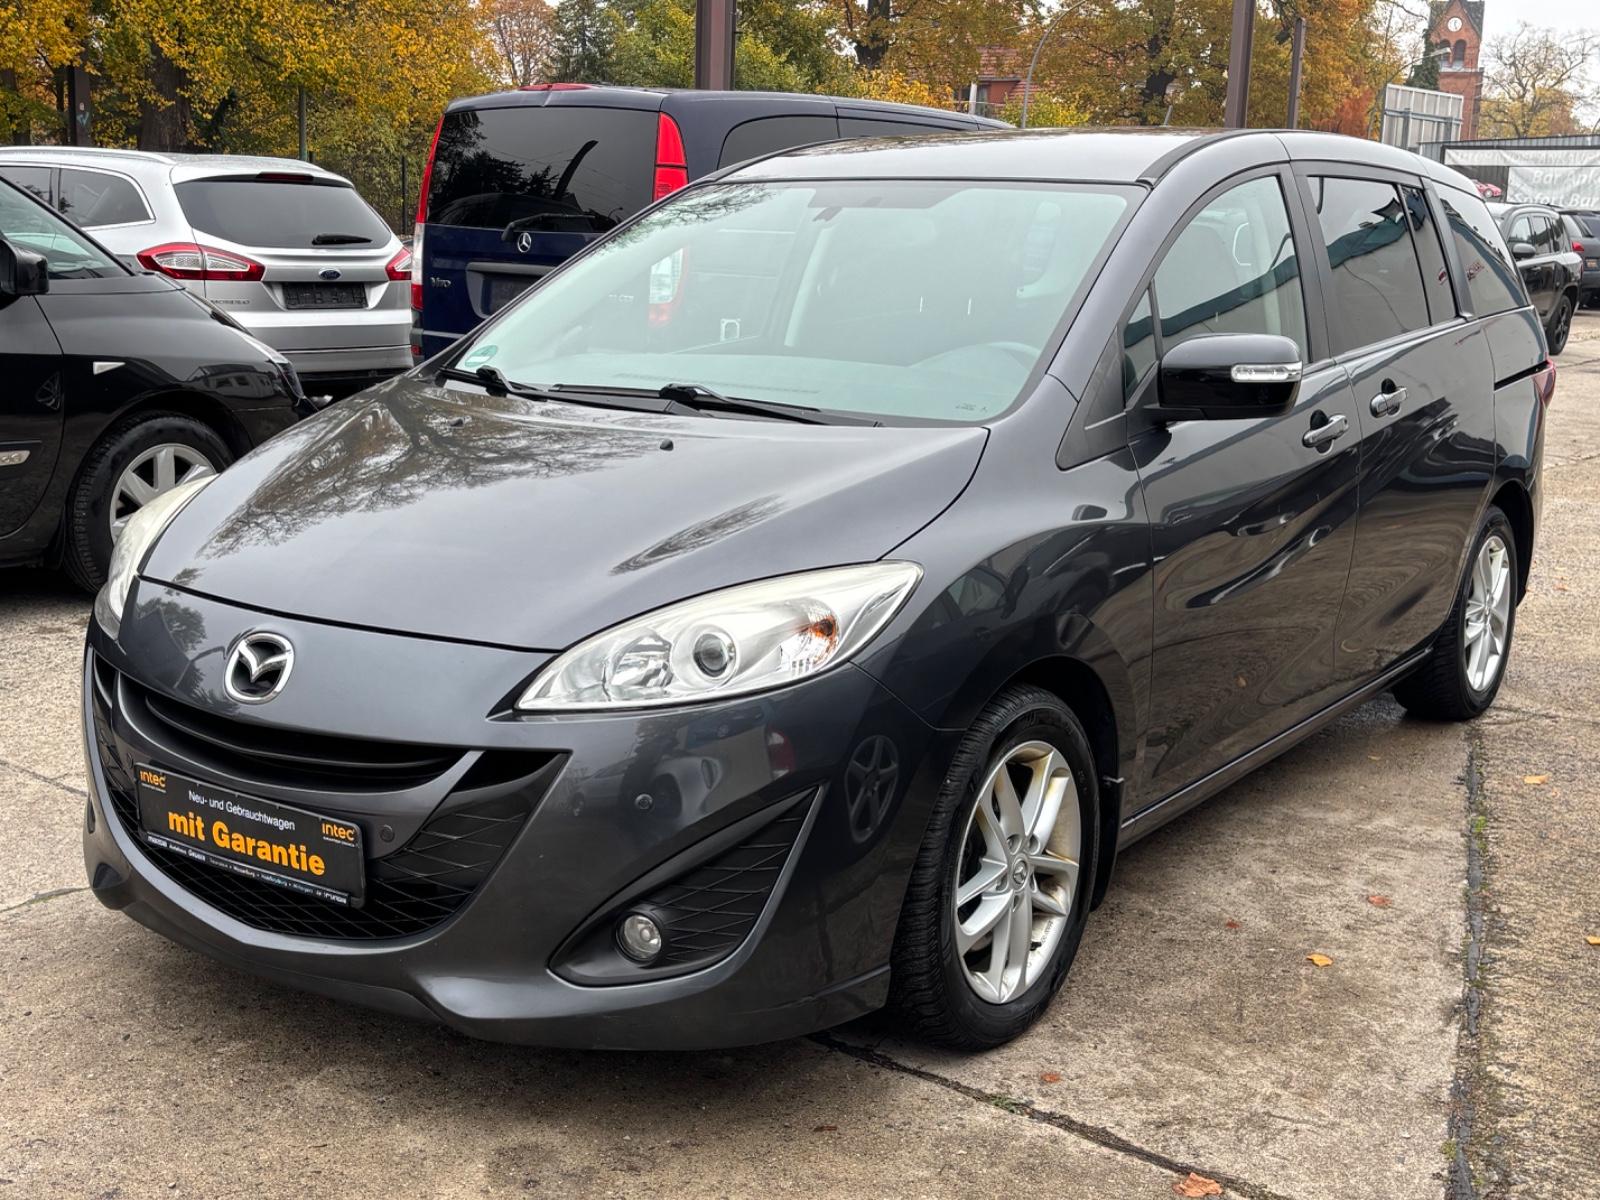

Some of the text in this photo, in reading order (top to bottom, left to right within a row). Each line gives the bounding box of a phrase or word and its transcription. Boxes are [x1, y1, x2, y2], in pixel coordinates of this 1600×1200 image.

[1533, 170, 1561, 185] Bar
[139, 770, 166, 788] intec
[188, 790, 296, 831] Neu- und Gebrauchtwagen
[322, 822, 355, 842] intec
[168, 811, 326, 876] mit Garantie
